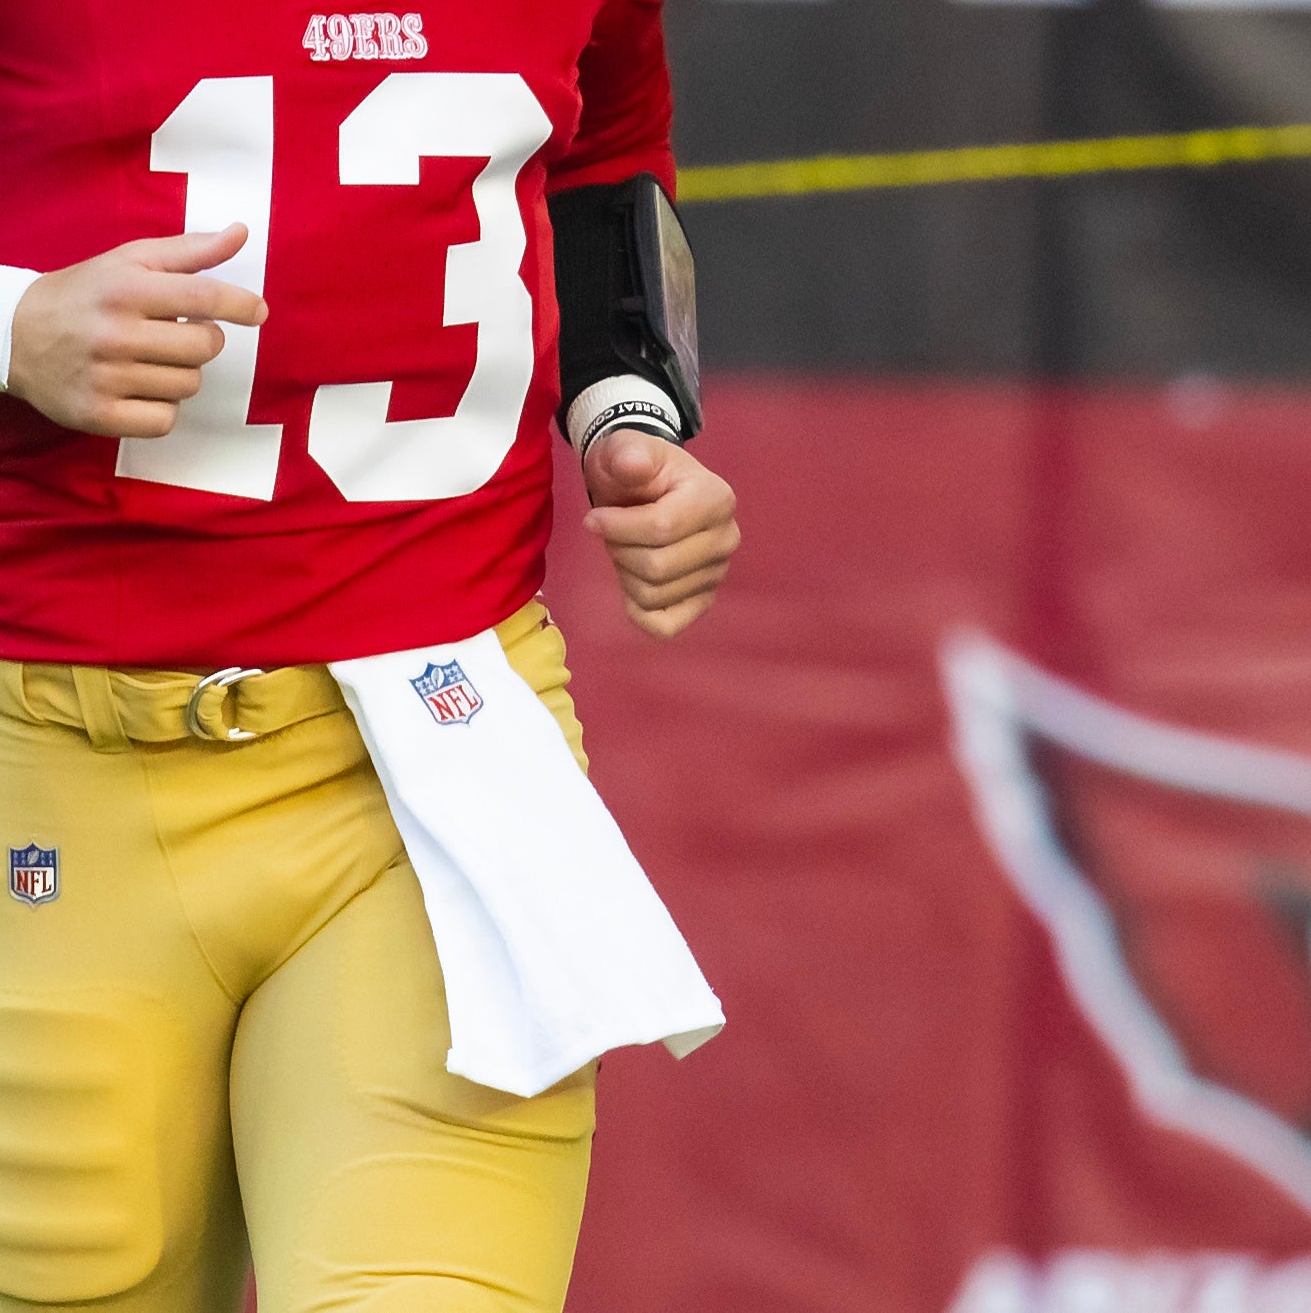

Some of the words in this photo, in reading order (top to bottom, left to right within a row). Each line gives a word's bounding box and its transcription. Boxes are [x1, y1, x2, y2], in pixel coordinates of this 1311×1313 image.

[302, 13, 428, 61] 49ERS
[115, 72, 553, 502] 13
[618, 401, 662, 416] GREAT
[427, 684, 479, 721] NFL
[16, 870, 52, 896] NFL
